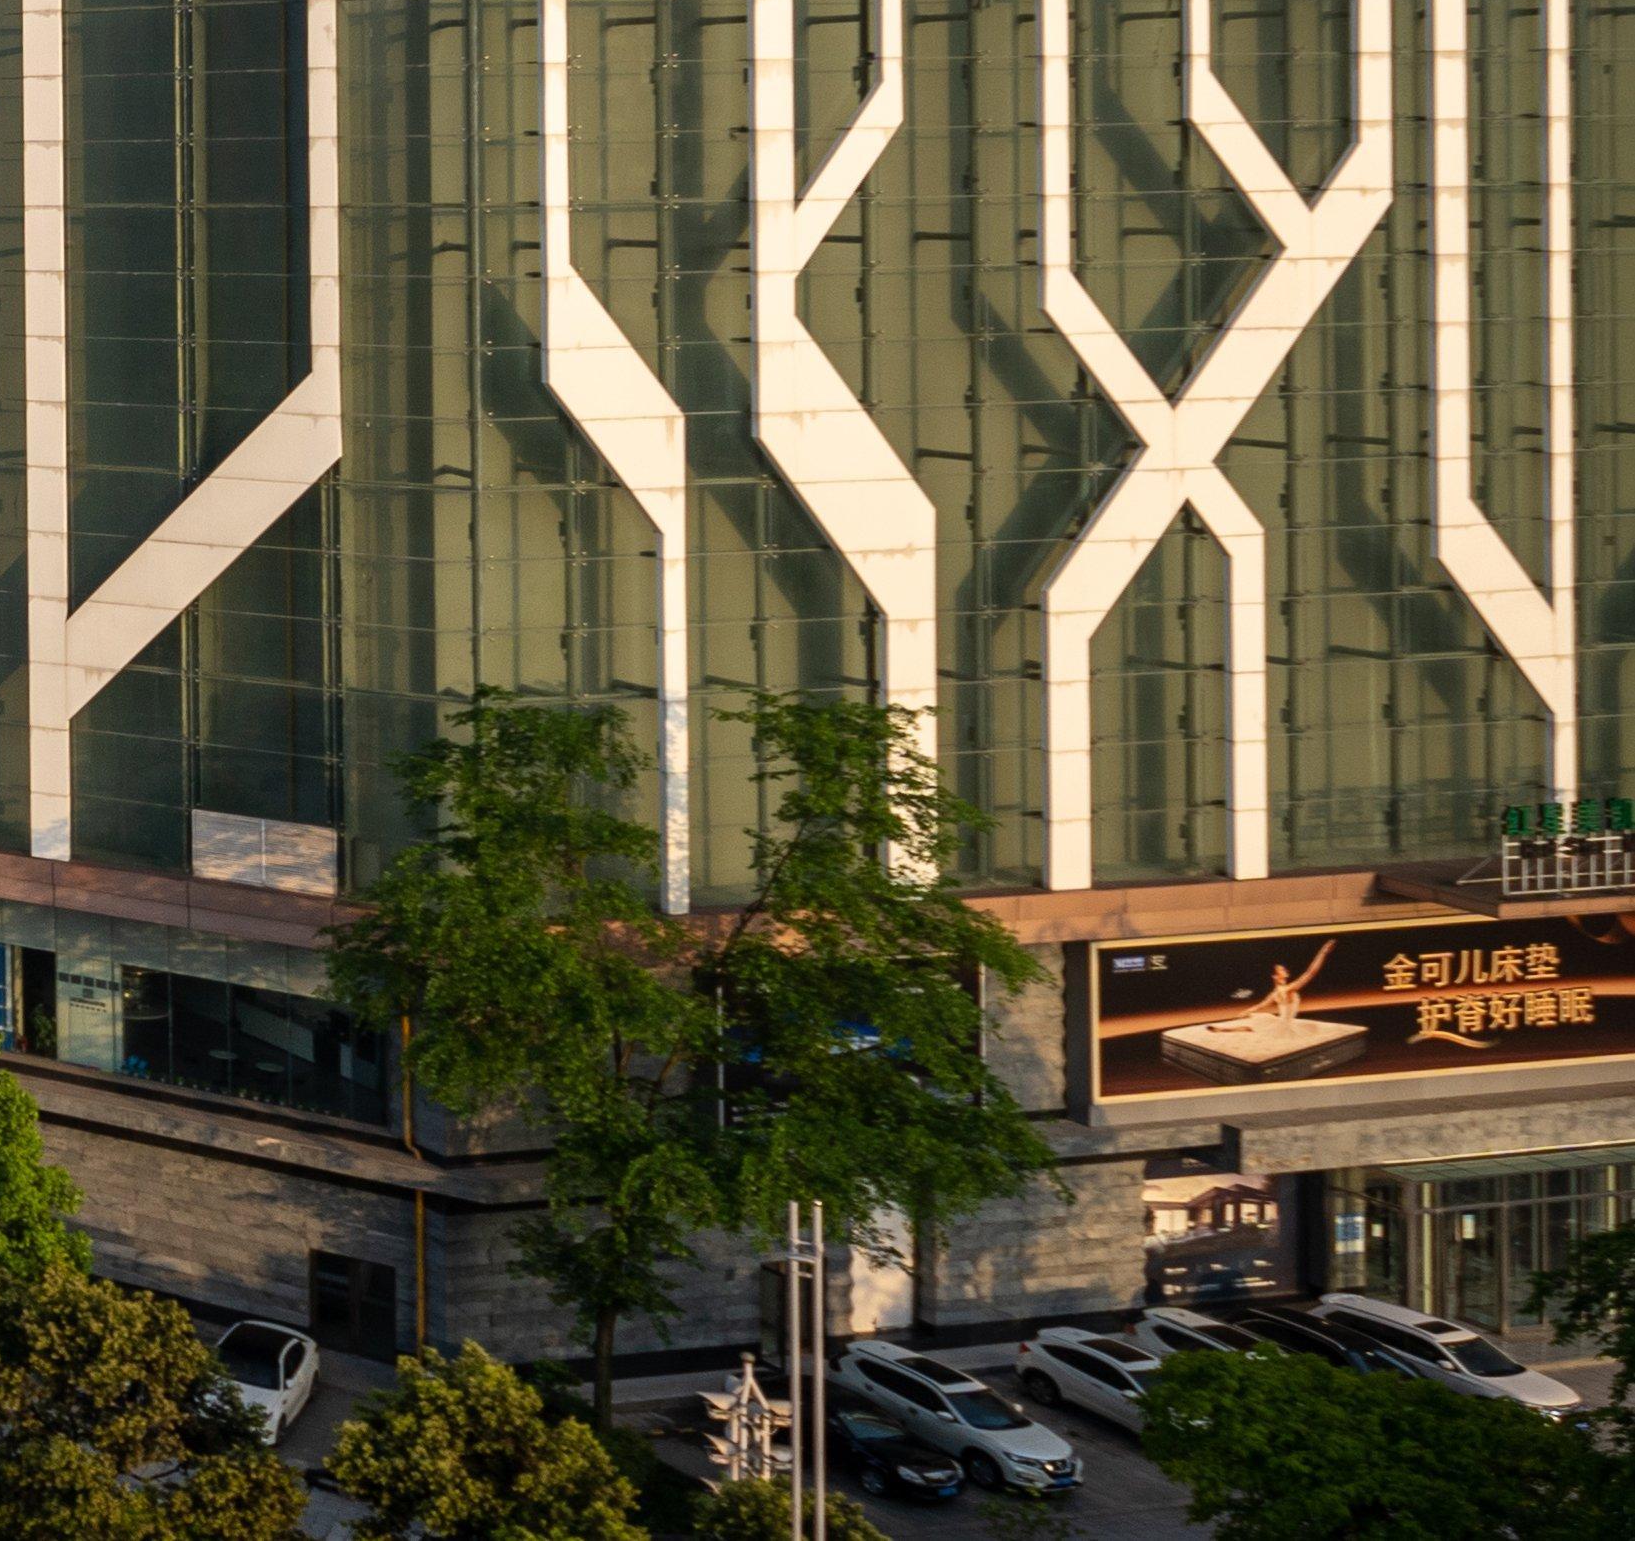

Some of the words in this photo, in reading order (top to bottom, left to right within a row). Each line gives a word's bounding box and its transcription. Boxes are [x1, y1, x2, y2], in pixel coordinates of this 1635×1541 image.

[1383, 942, 1561, 991] 金可儿床垫
[1416, 986, 1596, 1034] 护脊好睡眠
